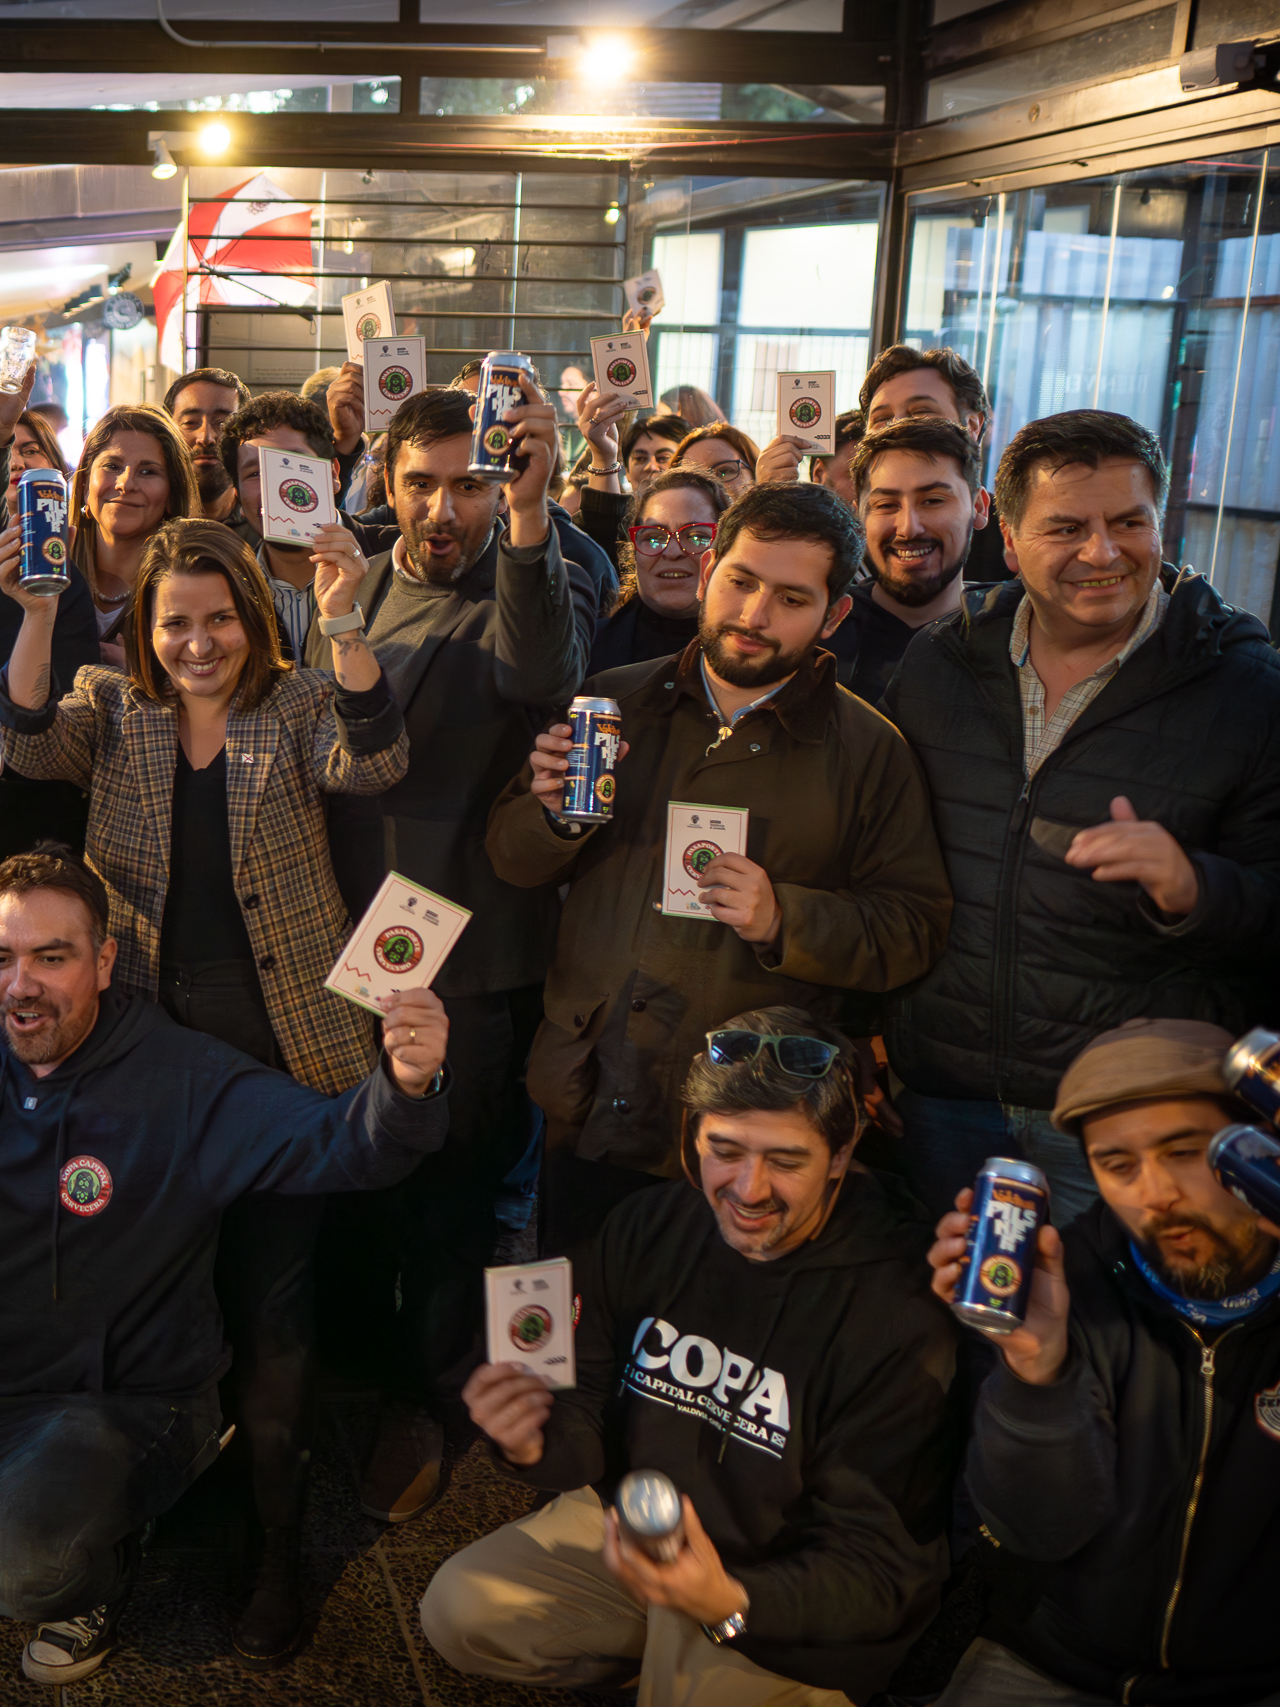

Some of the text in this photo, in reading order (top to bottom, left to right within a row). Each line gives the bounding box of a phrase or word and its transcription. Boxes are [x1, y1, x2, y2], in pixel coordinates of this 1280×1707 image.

[62, 1159, 108, 1187] COPA CAPITAL
[61, 1192, 104, 1212] CERVECERA
[632, 1317, 790, 1432] COPA
[634, 1371, 696, 1403] CAPITAL
